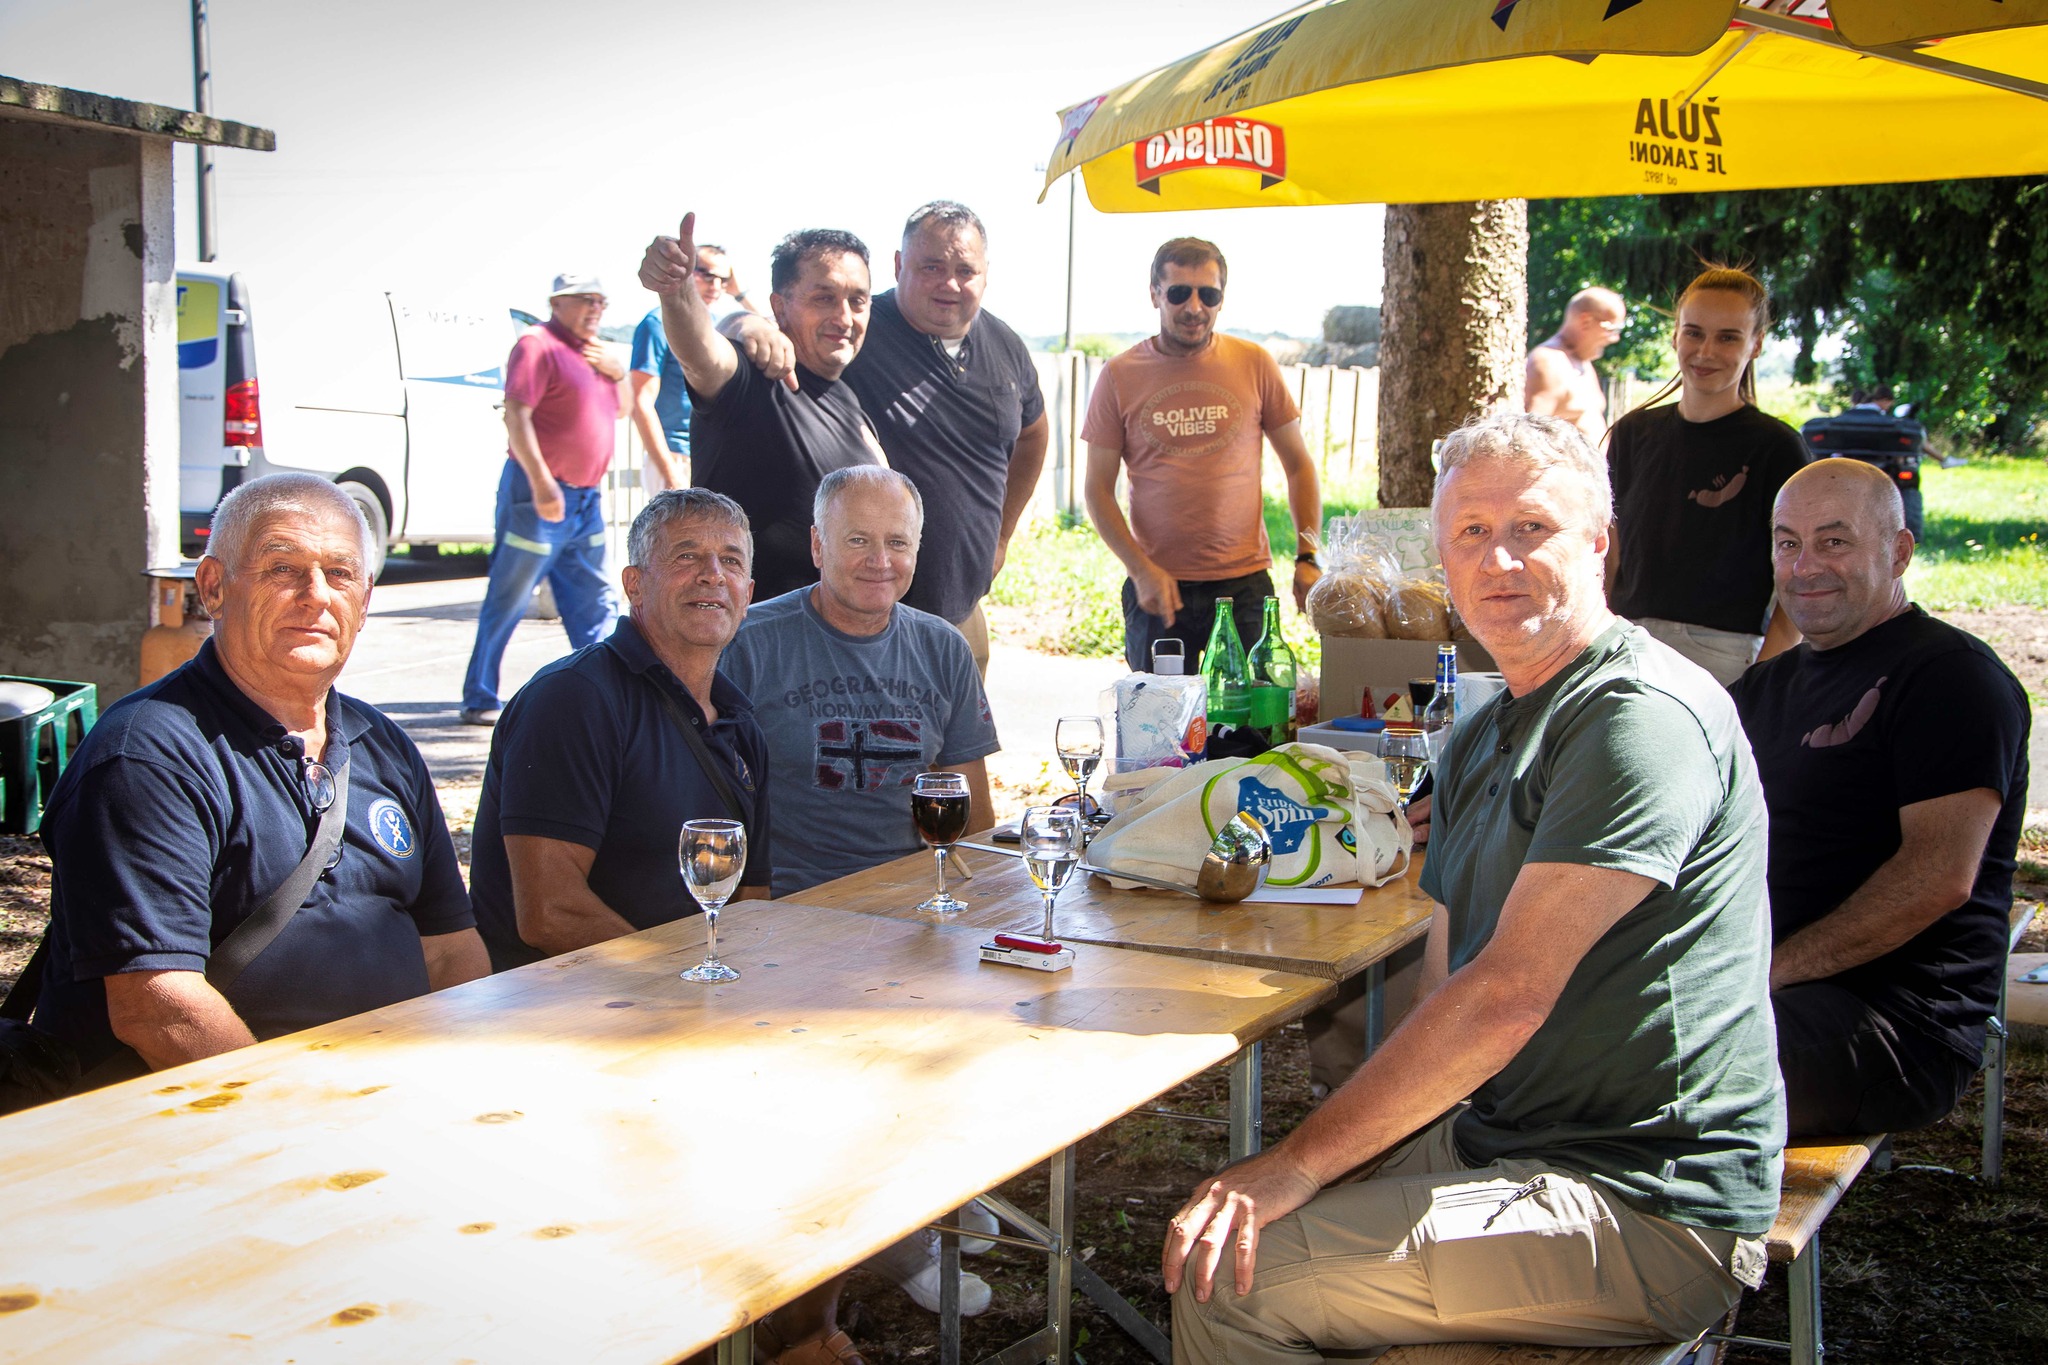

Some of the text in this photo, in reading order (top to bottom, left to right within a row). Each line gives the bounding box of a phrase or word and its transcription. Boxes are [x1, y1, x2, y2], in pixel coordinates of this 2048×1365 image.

[1152, 405, 1229, 426] S.OLIVER
[1167, 420, 1217, 438] VIBES
[783, 675, 941, 712] GEOGRAPHICAL
[808, 702, 924, 720] NORWAY 1953
[1256, 803, 1315, 833] Spin
